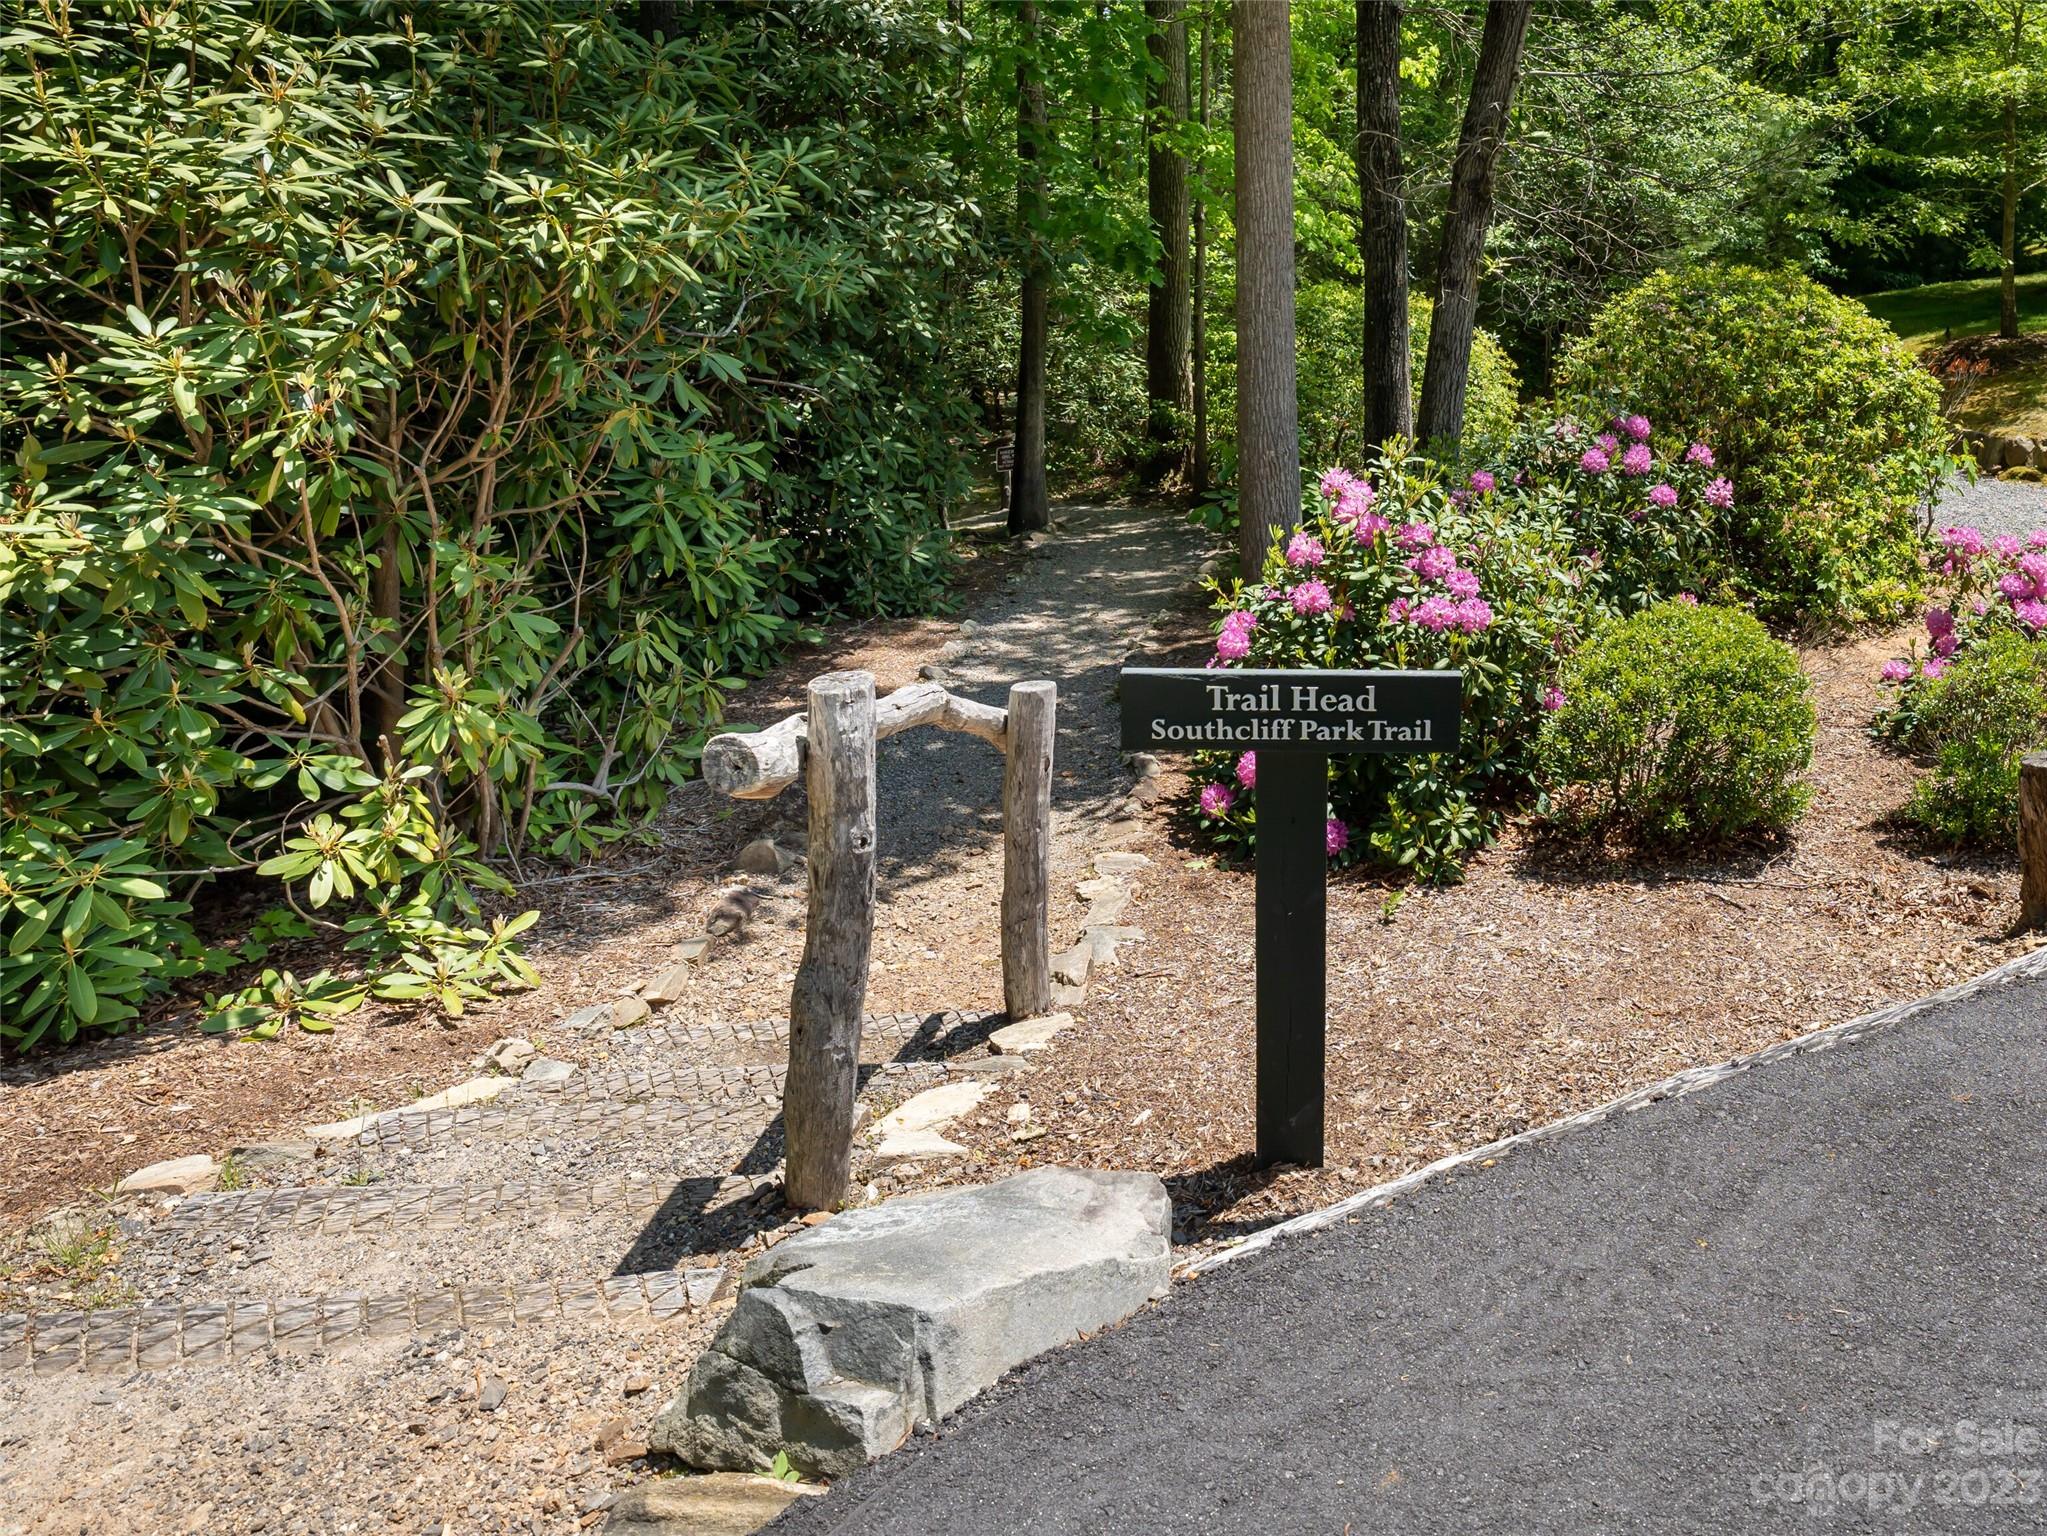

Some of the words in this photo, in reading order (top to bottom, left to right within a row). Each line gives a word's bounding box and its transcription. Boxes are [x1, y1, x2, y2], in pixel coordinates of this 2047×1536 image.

[1205, 684, 1281, 712] Trail
[1290, 685, 1378, 713] Head
[1151, 718, 1296, 741] Southcliff
[1299, 719, 1364, 742] Park
[1367, 719, 1433, 742] Trail
